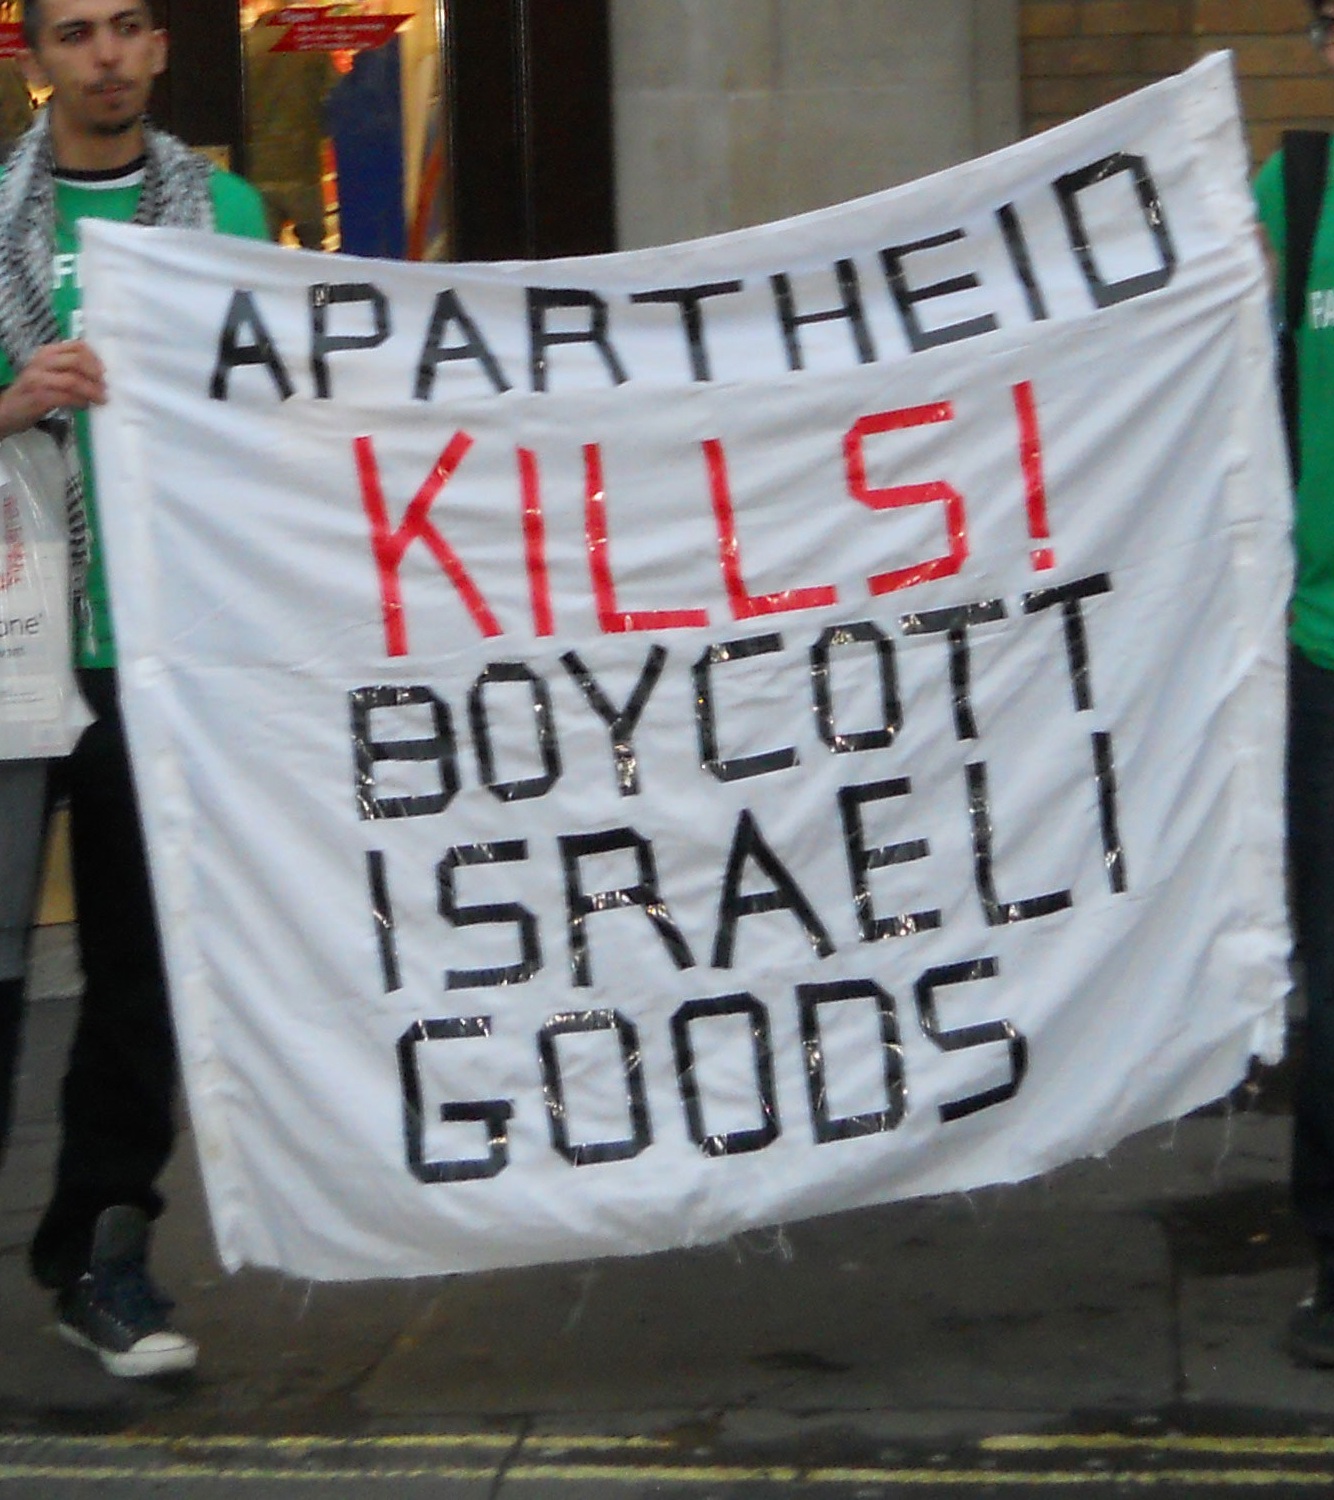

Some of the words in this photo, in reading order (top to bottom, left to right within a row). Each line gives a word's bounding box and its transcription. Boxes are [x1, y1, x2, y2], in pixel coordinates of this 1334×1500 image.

[208, 151, 1179, 401] APARTHEID
[353, 380, 1055, 657] KILLS!
[349, 572, 1113, 821] BOYCOTT
[365, 730, 1129, 994] ISRAELI
[396, 957, 1029, 1185] GOODS
